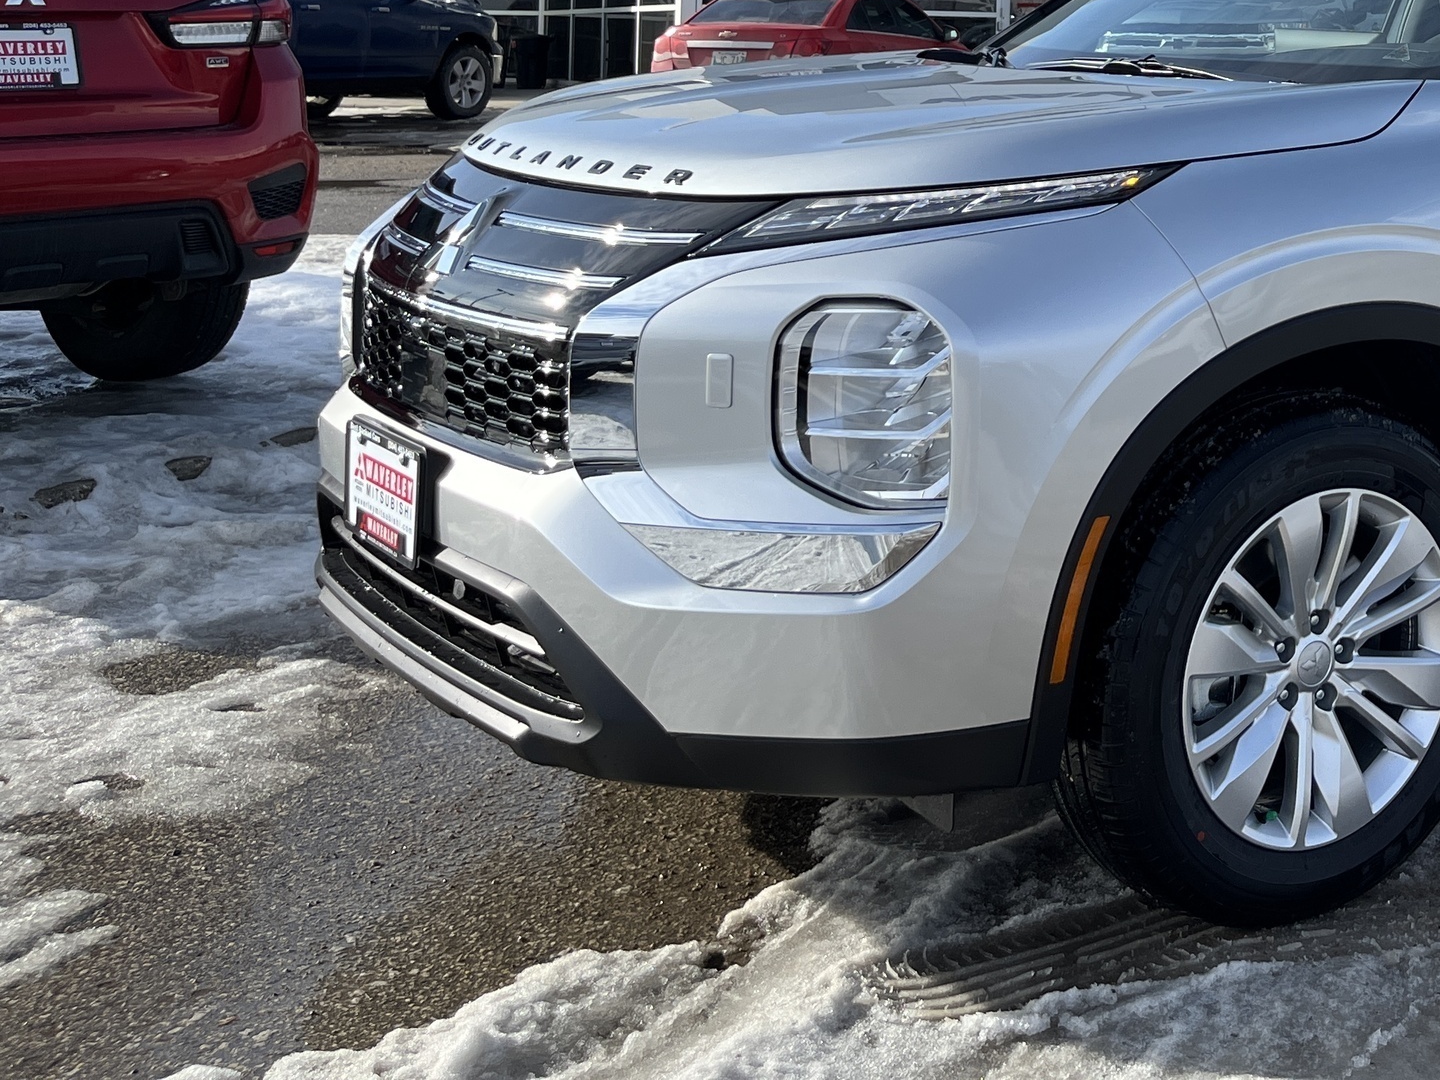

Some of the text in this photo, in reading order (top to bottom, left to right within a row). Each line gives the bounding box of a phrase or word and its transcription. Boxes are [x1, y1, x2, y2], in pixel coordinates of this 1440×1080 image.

[467, 133, 694, 186] OUTLANDER
[365, 458, 413, 504] WAVERLEY
[366, 483, 412, 521] MITSUBISHI
[366, 516, 398, 547] WAVERLEY
